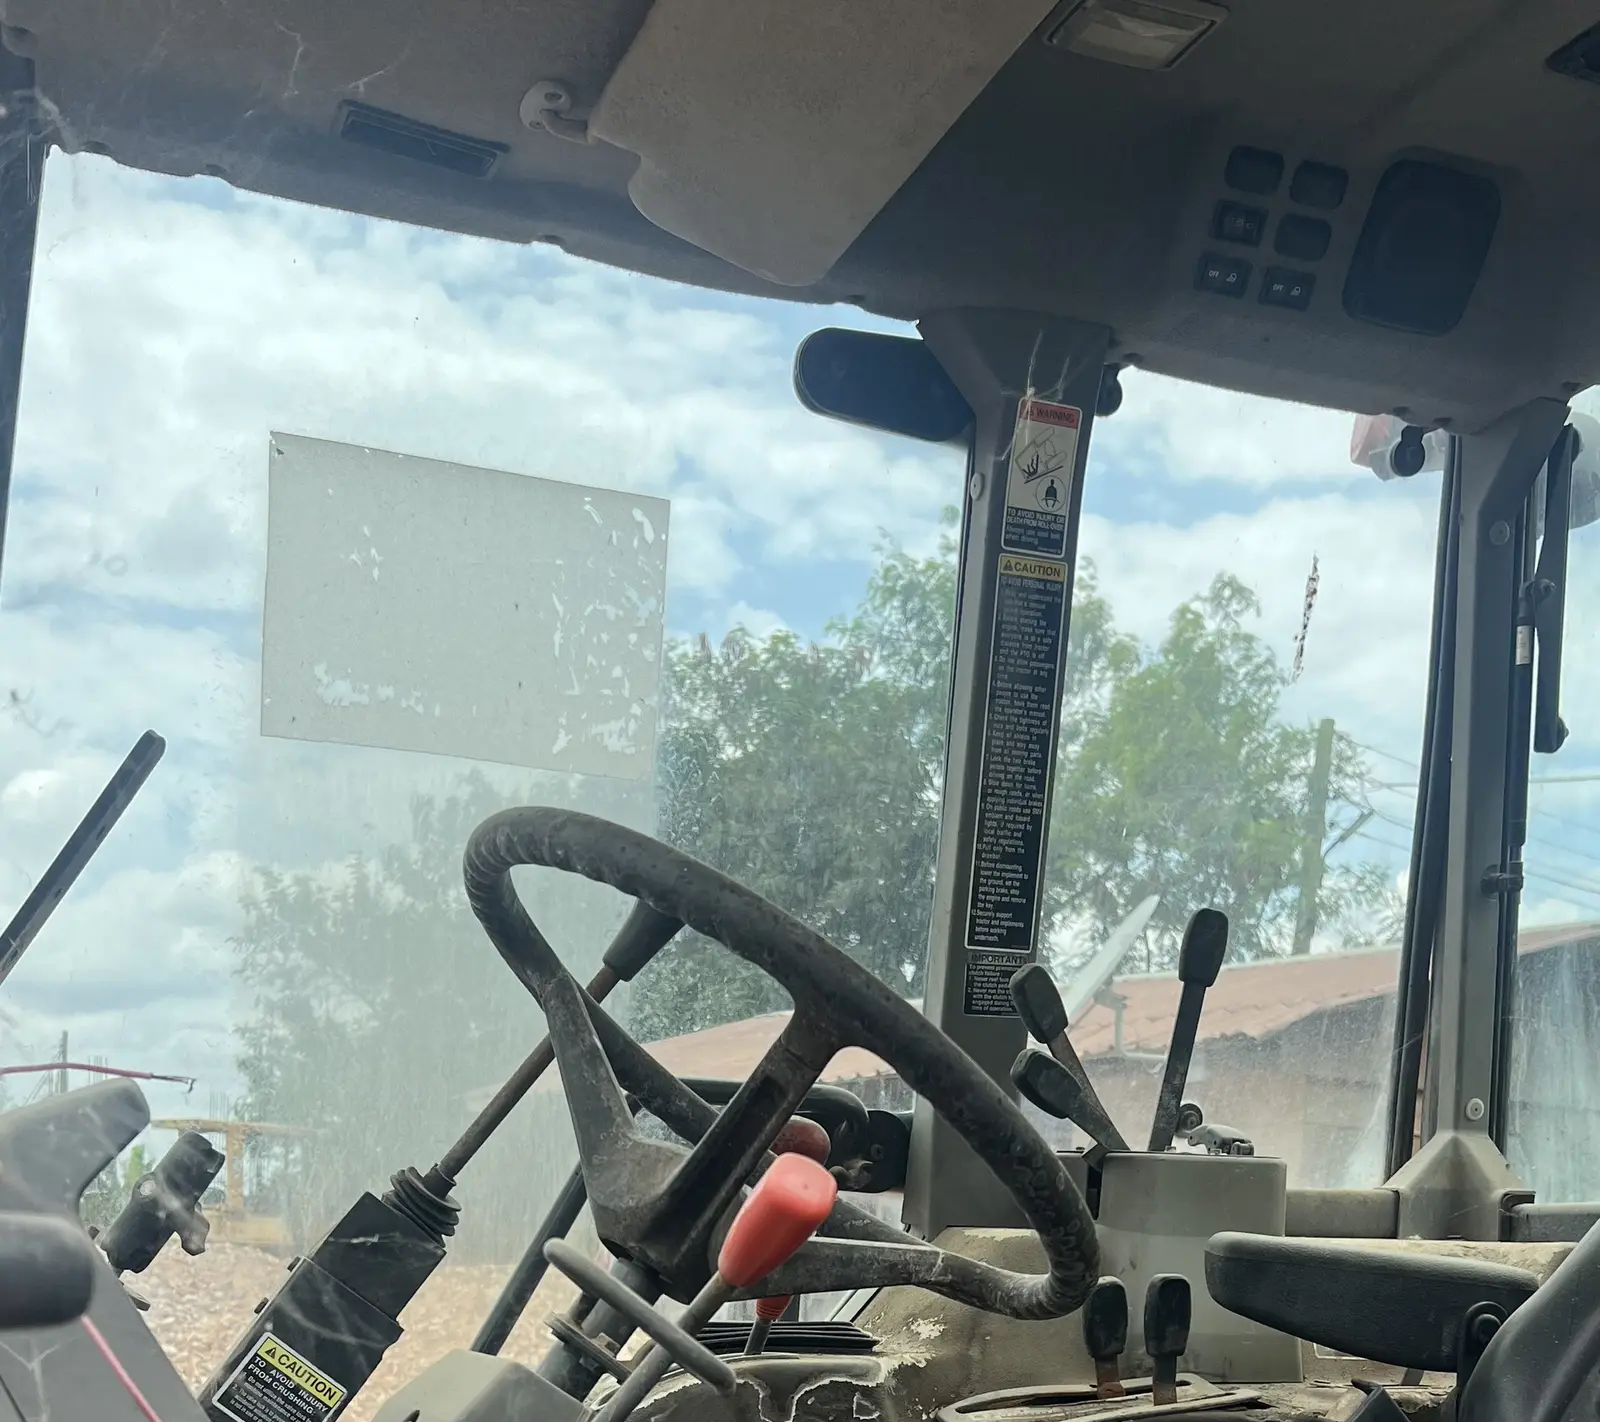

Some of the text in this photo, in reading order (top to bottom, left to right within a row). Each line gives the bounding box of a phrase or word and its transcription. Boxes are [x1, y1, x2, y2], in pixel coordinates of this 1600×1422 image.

[1036, 407, 1075, 424] WARNING
[1007, 507, 1016, 516] TO
[1017, 509, 1035, 519] AVOID
[1014, 561, 1061, 577] CAUTION
[253, 1356, 329, 1412] TO AVOID INJURY
[278, 1353, 337, 1401] CAUTION
[239, 1388, 248, 1397] The
[246, 1395, 257, 1404] valve
[256, 1401, 266, 1410] lock
[247, 1363, 316, 1416] FROM CRUSHING:
[247, 1375, 256, 1384] Do
[254, 1381, 264, 1390] not
[262, 1387, 277, 1400] utilize
[276, 1396, 285, 1406] the
[284, 1403, 297, 1414] valve
[295, 1411, 307, 1421] lock
[233, 1402, 242, 1410] not
[262, 1395, 291, 1418] maintenance
